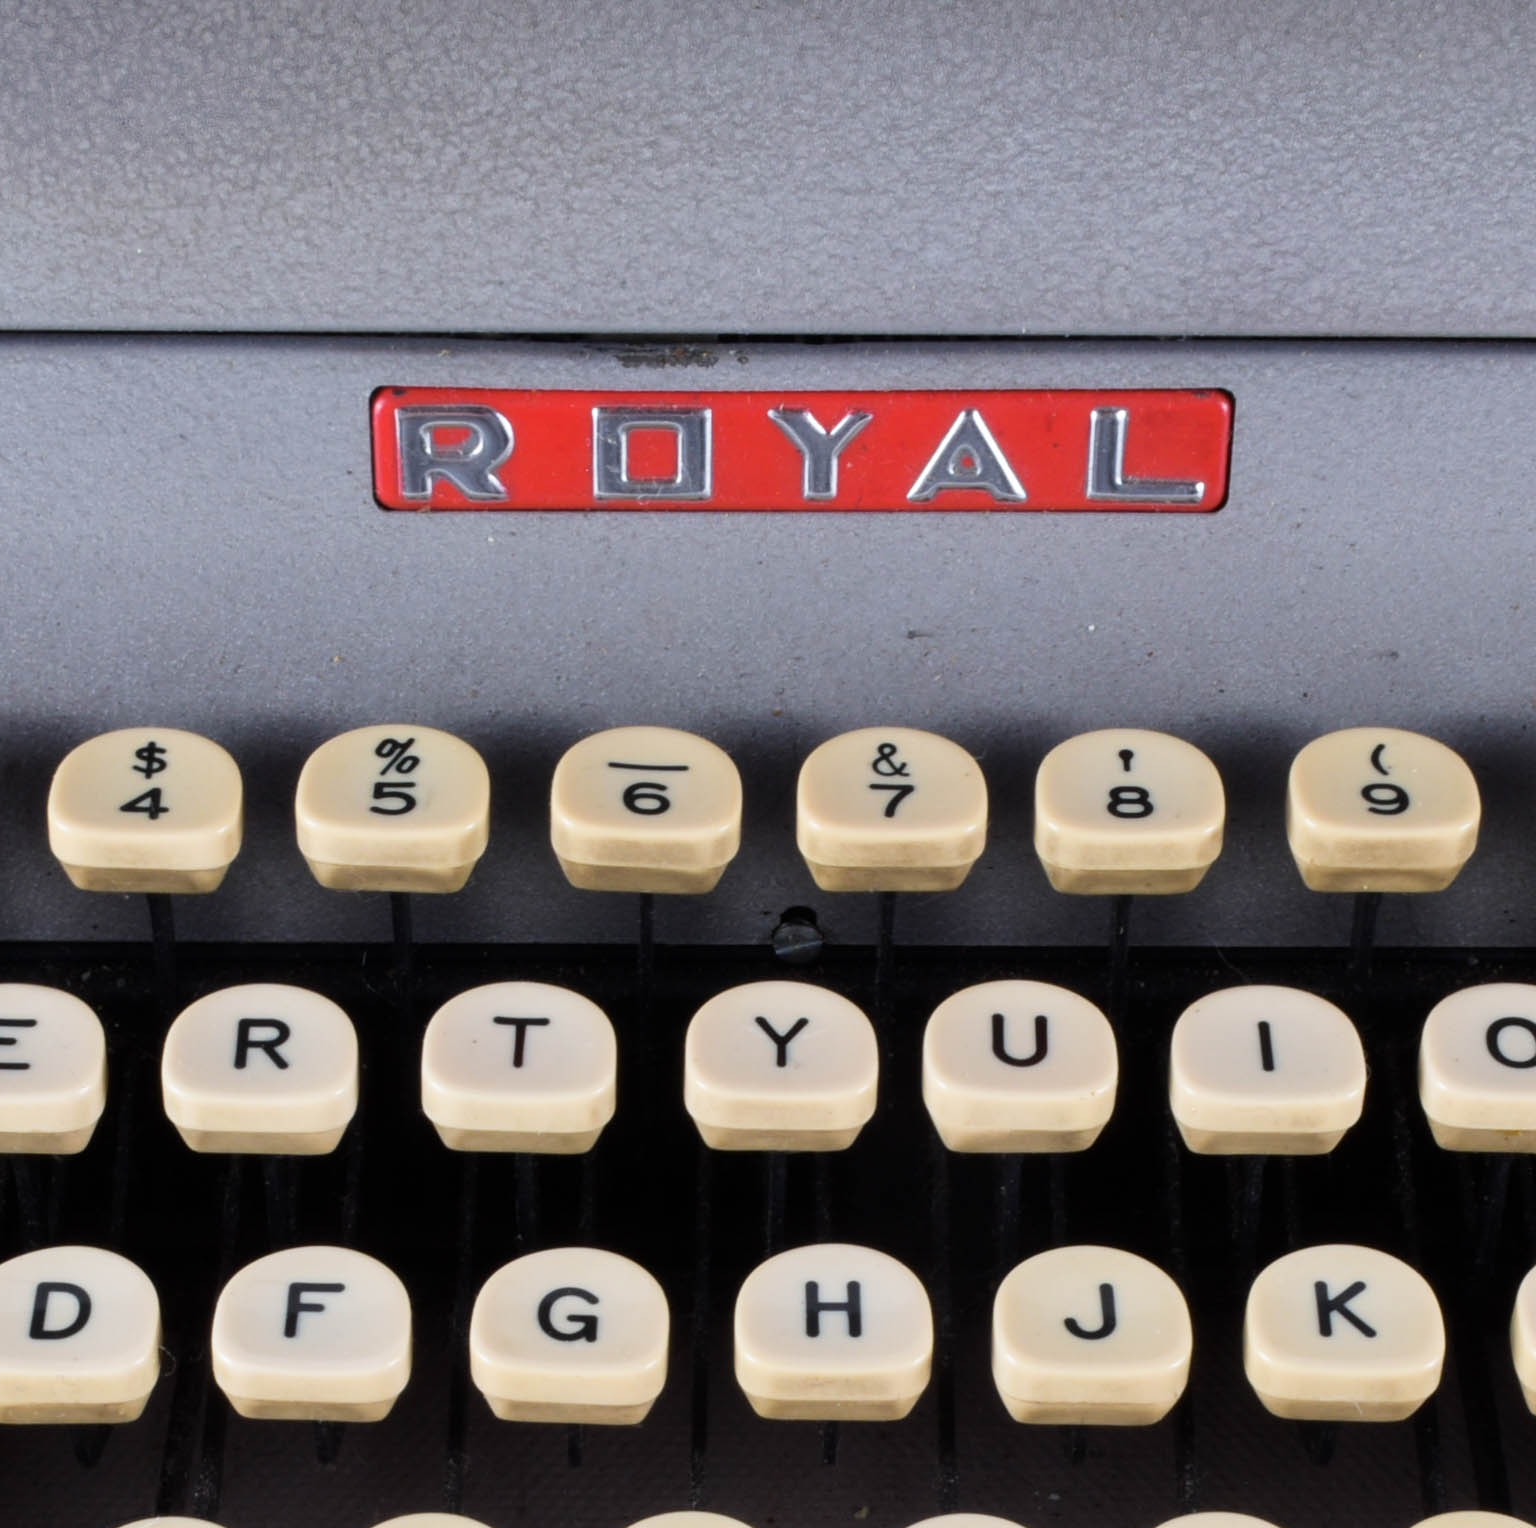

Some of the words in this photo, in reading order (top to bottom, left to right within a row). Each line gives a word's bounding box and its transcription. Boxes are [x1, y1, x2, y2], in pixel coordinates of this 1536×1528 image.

[393, 405, 1206, 503] ROYAL
[129, 739, 170, 782] $
[372, 735, 423, 779] %
[869, 740, 913, 780] &
[1368, 741, 1392, 778] (
[116, 785, 172, 823] 4
[367, 779, 419, 818] 5
[620, 779, 673, 818] 6
[866, 781, 917, 821] 7
[1104, 783, 1157, 822] 8
[1358, 780, 1413, 818] 9
[231, 1015, 293, 1072] R
[490, 1013, 553, 1071] T
[752, 1013, 811, 1070] Y
[989, 1011, 1051, 1070] U
[1255, 1018, 1278, 1075] I
[26, 1279, 94, 1343] D
[281, 1280, 348, 1341] F
[534, 1284, 602, 1346] G
[802, 1278, 865, 1341] H
[1061, 1280, 1119, 1343] J
[1312, 1278, 1379, 1341] K
